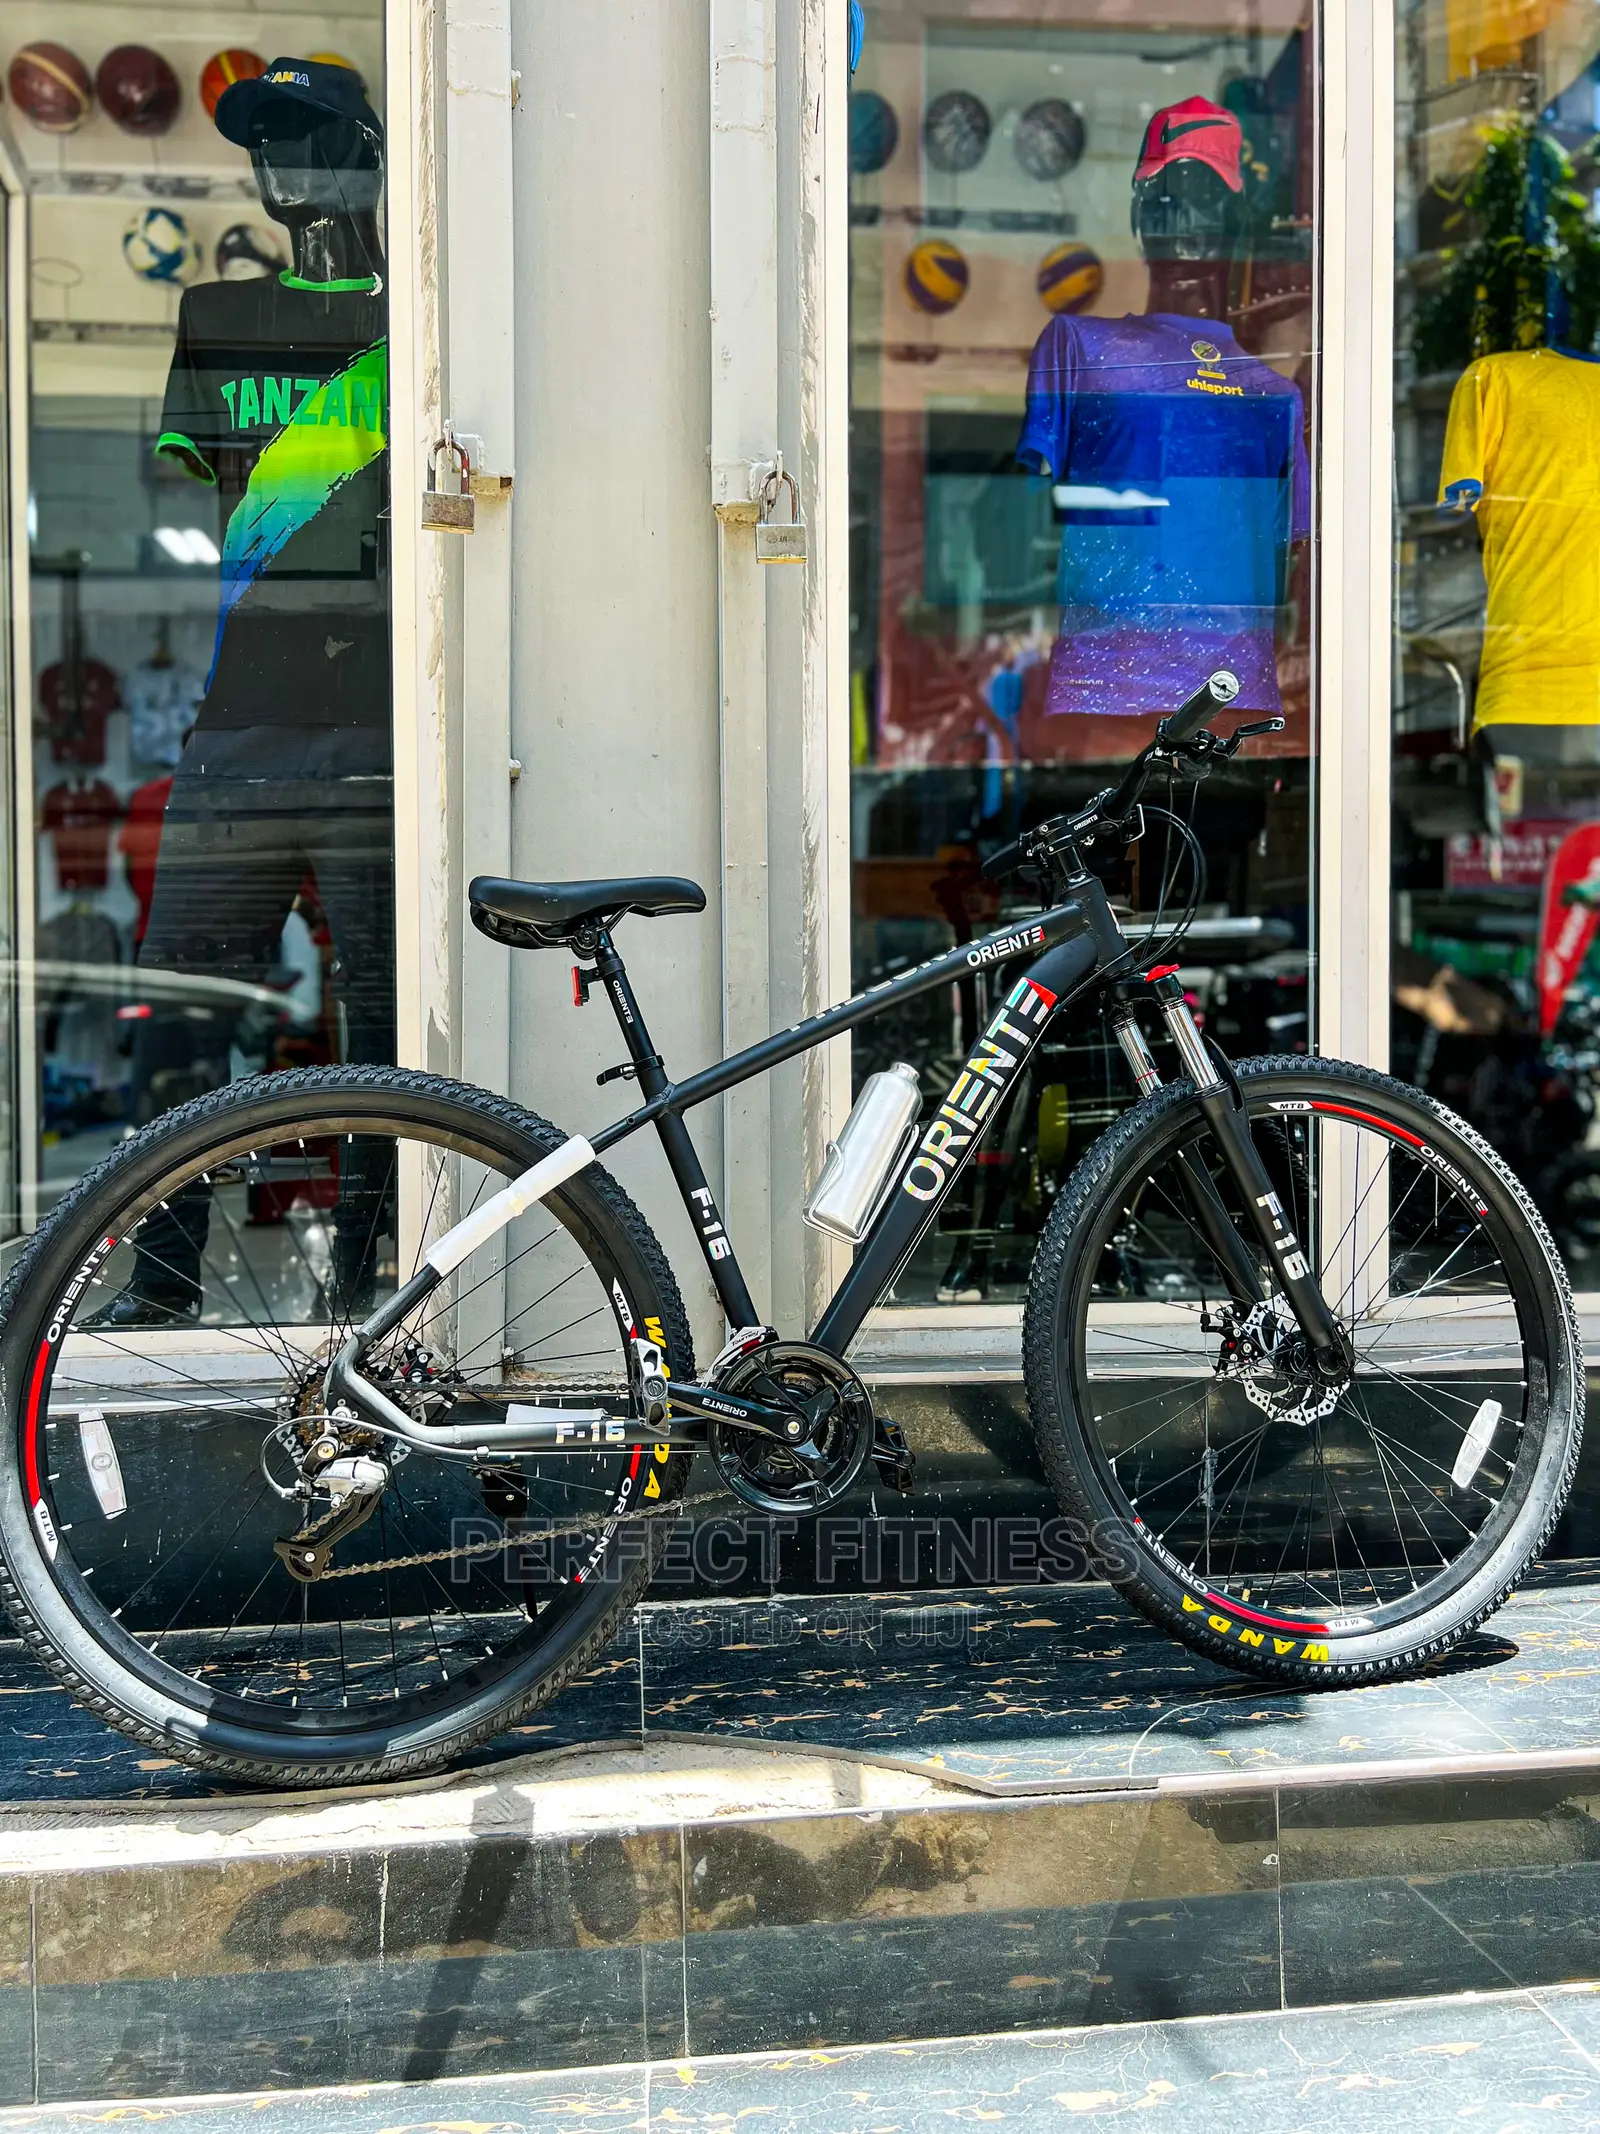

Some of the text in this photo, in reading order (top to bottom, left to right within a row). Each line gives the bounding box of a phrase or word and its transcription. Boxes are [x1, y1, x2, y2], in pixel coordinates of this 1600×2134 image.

[220, 376, 387, 432] TANZAN
[1187, 378, 1244, 396] uhlsport
[1073, 814, 1099, 831] ORIENTE
[966, 925, 1046, 967] ORIENTE
[612, 980, 634, 1024] ORIENTE
[902, 976, 1058, 1201] ORIENTE
[1420, 1145, 1488, 1216] ORIENTE
[691, 1186, 732, 1261] F-16
[1255, 1190, 1310, 1280] F-16
[47, 1236, 116, 1343] ORIENTE
[614, 1292, 630, 1322] MTB
[555, 1420, 626, 1444] F-16
[702, 1397, 748, 1417] ORIENTE
[39, 1510, 56, 1542] MTB
[573, 1476, 632, 1584] ORENTE
[1133, 1516, 1209, 1594] ORIENTE
[1181, 1594, 1330, 1661] WANDA
